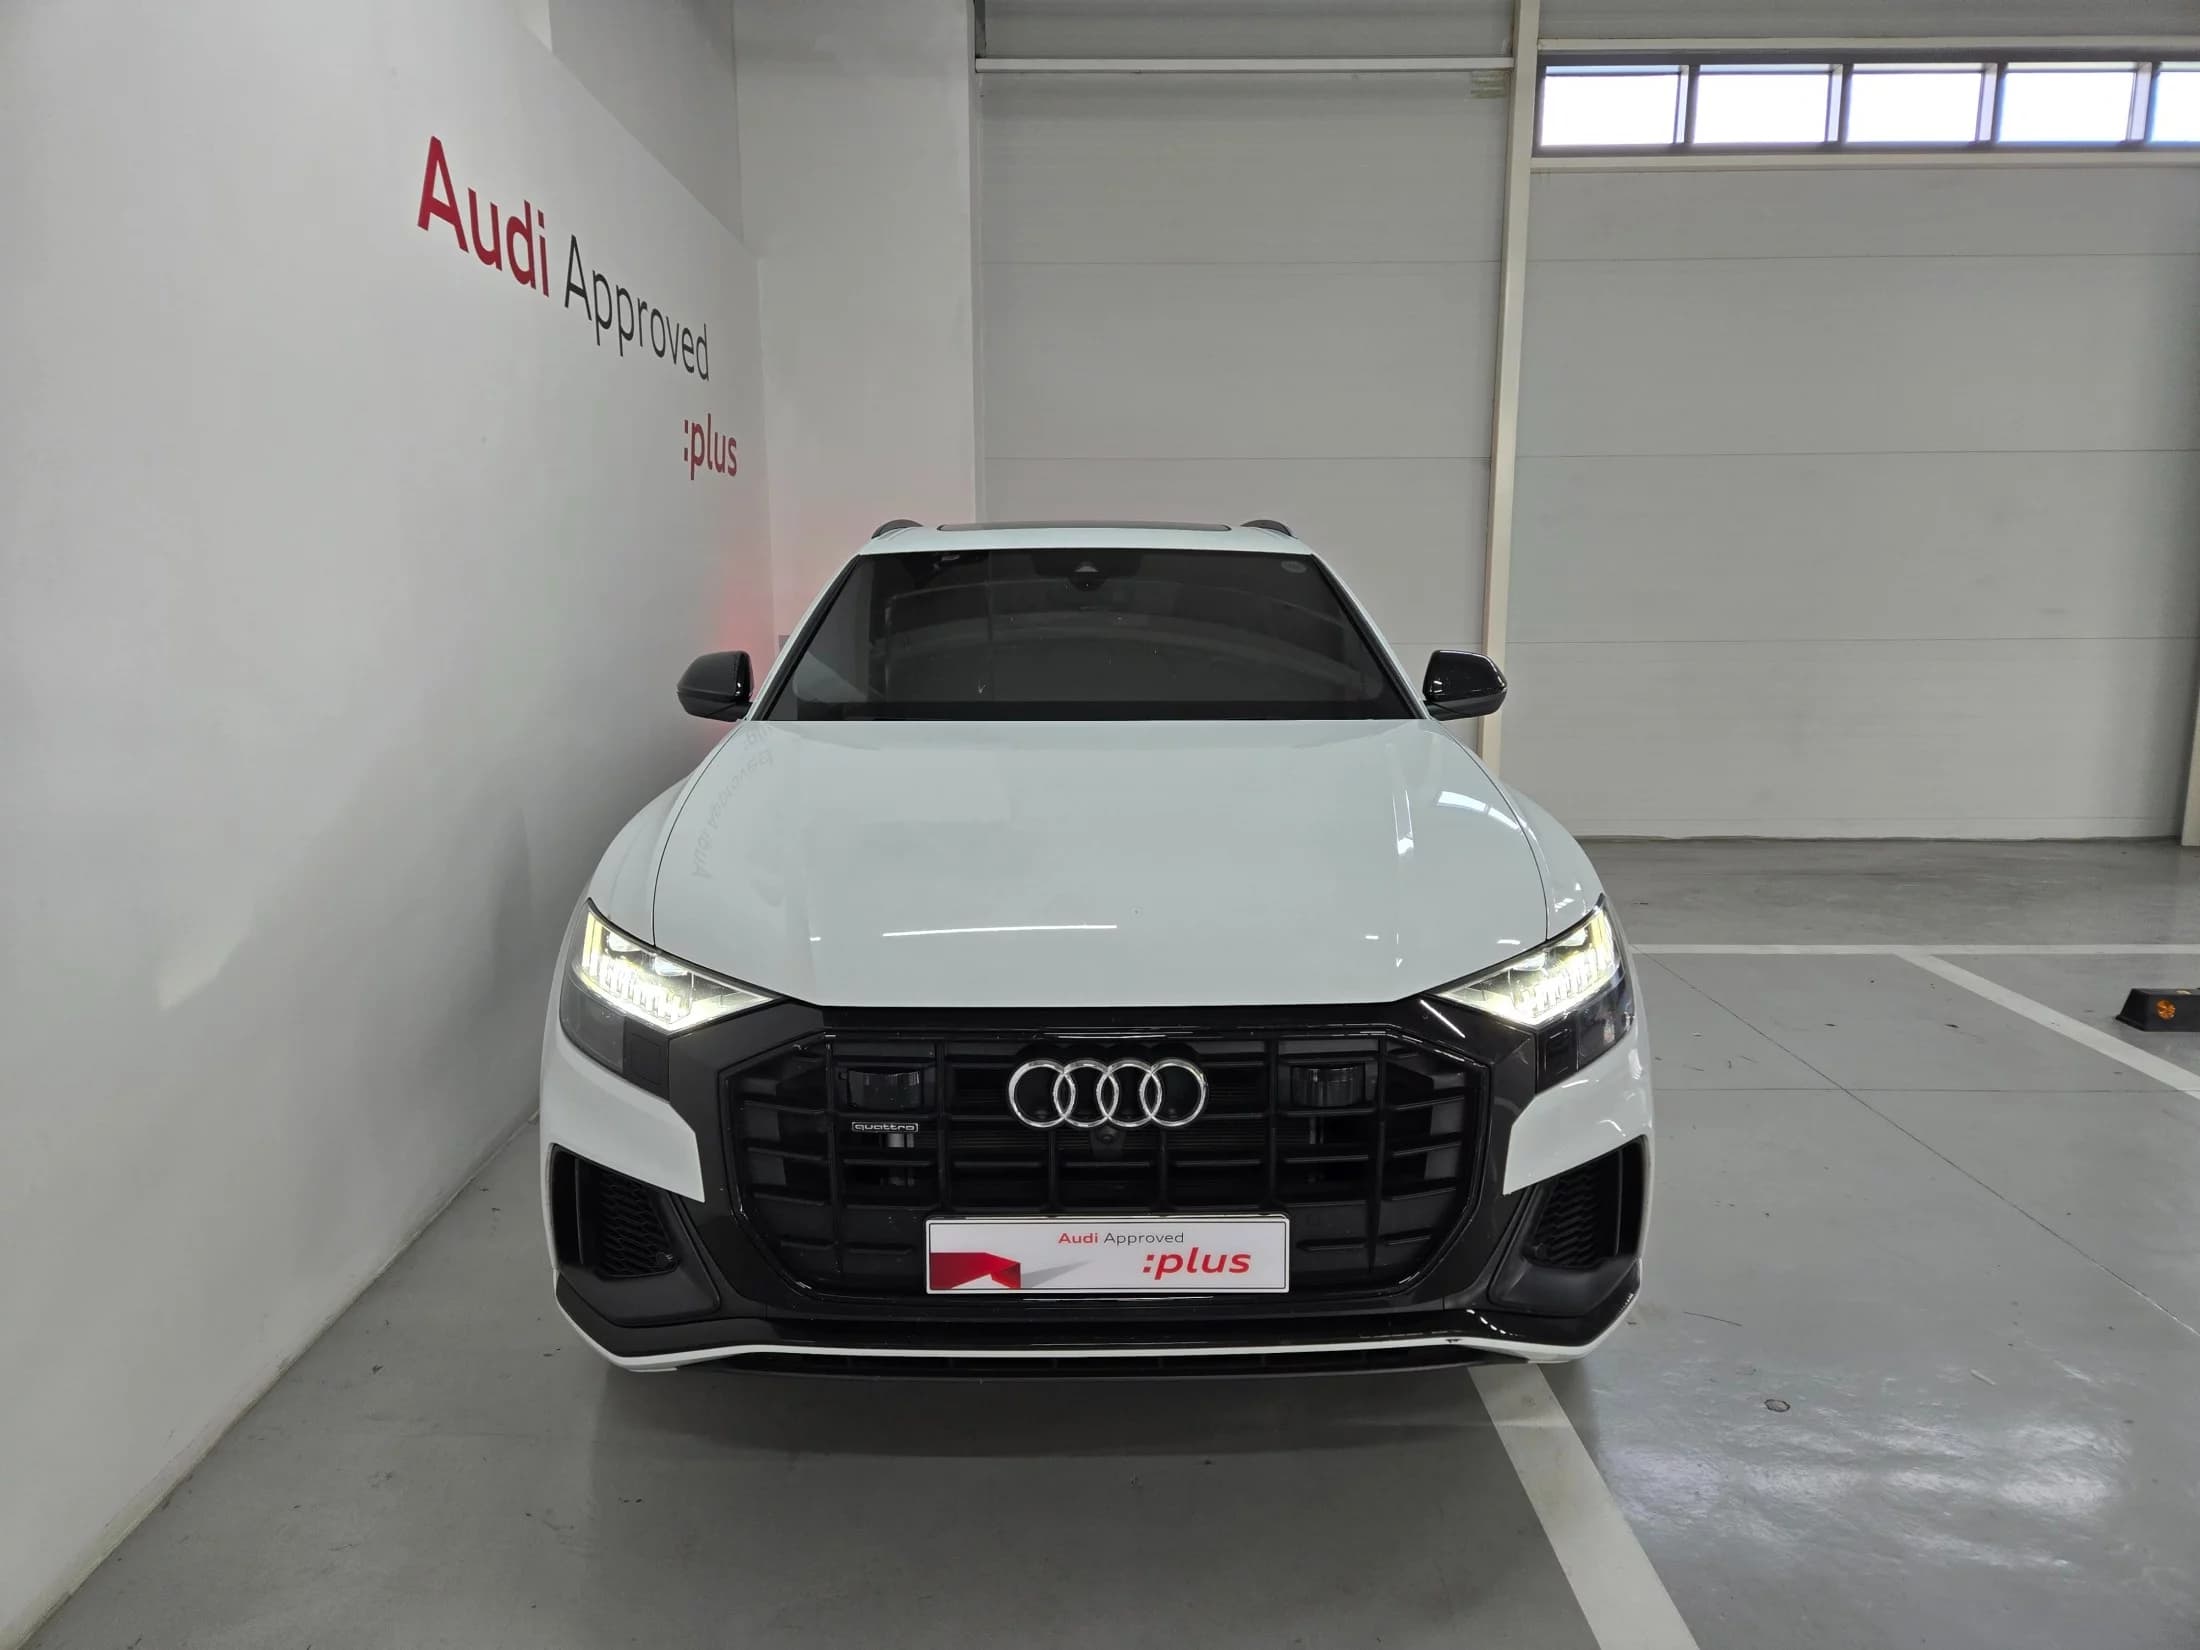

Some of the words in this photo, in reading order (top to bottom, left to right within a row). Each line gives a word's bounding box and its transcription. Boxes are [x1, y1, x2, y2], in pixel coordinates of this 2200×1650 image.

[417, 135, 549, 298] Audi
[564, 234, 709, 381] Approved
[684, 413, 737, 480] :plus
[853, 1123, 916, 1131] quattro
[1058, 1232, 1099, 1245] Audi
[1103, 1232, 1184, 1247] Approved
[1142, 1247, 1252, 1280] :plus
